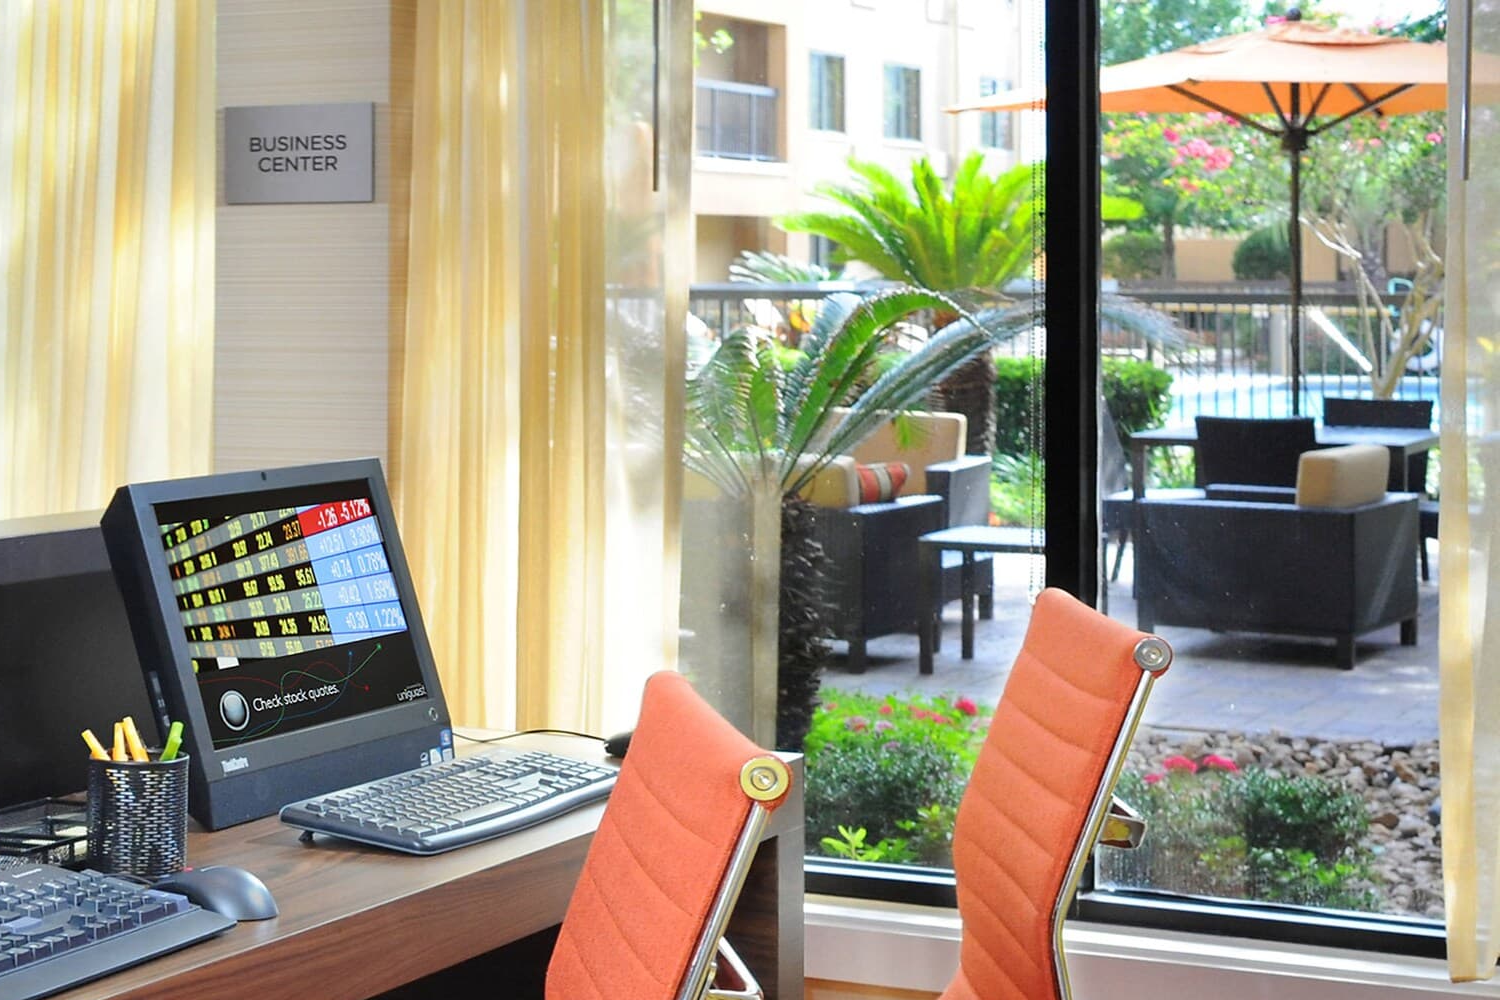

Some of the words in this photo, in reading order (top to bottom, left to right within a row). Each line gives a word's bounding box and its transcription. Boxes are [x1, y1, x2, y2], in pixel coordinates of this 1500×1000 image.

[249, 134, 347, 152] BUSINESS
[258, 156, 338, 172] CENTER
[317, 506, 338, 528] -1.26
[341, 499, 371, 520] -5.12%
[252, 694, 283, 712] Check
[283, 689, 308, 705] stock
[308, 684, 340, 702] quotes.
